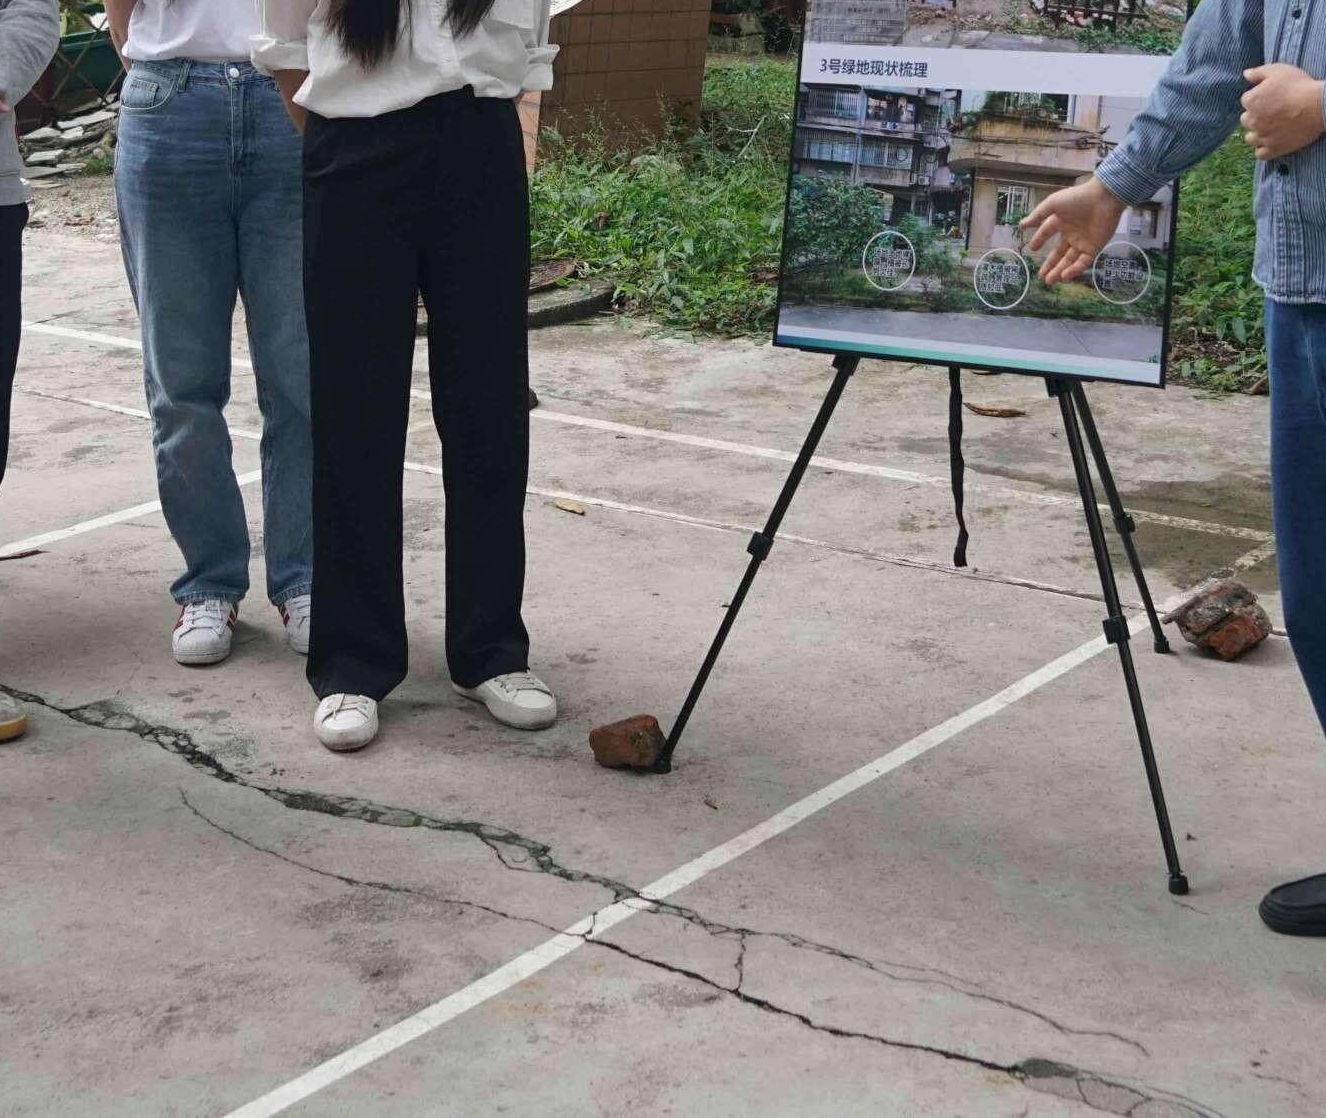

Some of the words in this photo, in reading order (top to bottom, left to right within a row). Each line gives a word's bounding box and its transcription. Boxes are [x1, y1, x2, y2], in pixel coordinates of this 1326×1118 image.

[819, 58, 929, 78] 3号绿地现状梳理
